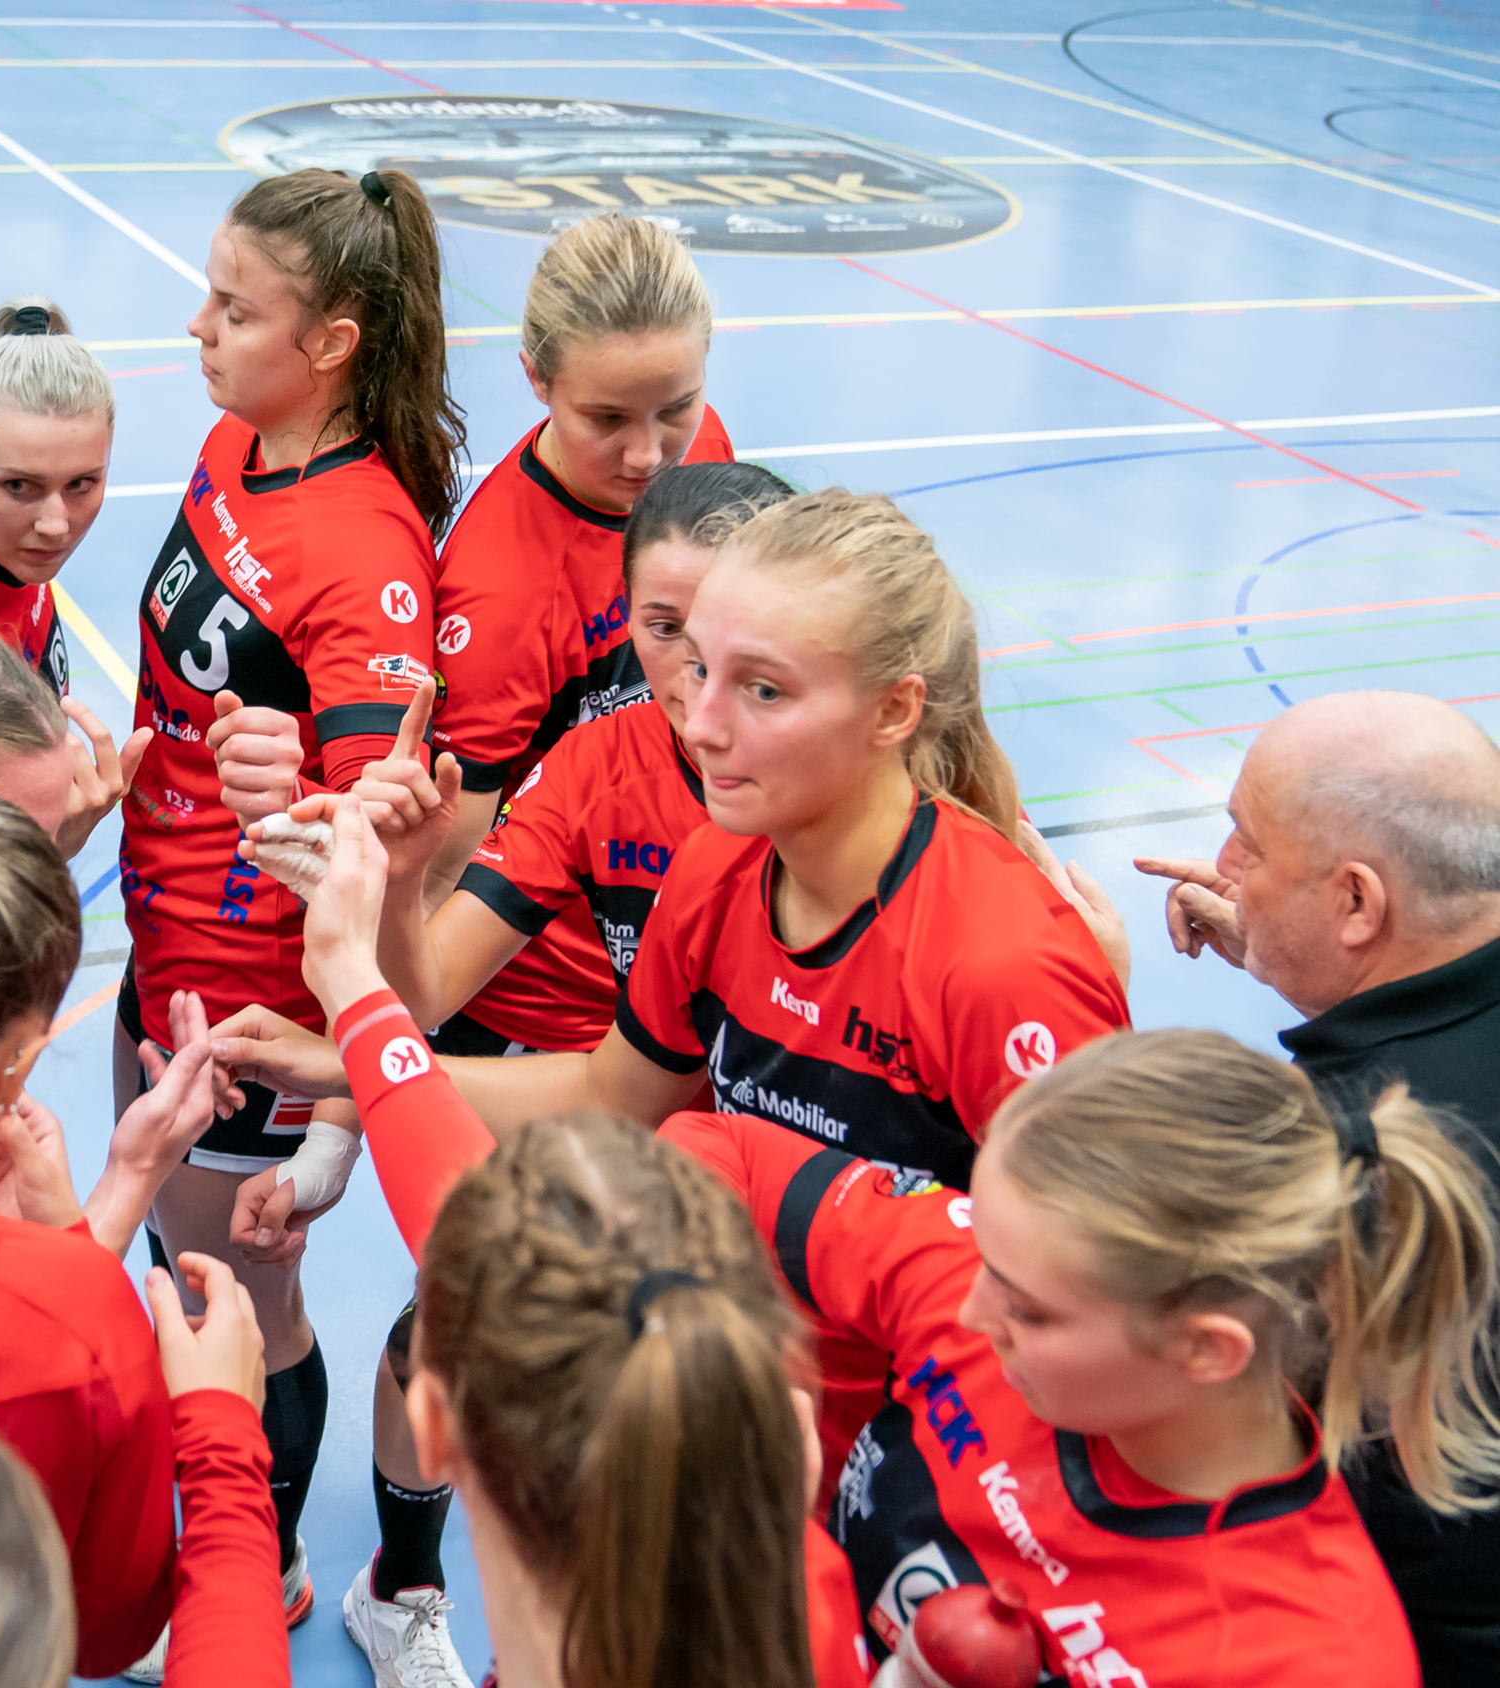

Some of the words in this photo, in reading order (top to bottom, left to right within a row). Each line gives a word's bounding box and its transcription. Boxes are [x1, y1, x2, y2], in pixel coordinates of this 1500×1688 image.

[436, 173, 934, 208] STARK
[211, 490, 238, 541] Kempa
[223, 536, 273, 595] hsc
[149, 594, 169, 627] SPAR
[180, 593, 250, 691] 5
[165, 789, 195, 813] 125
[219, 830, 262, 924] ASE
[731, 1076, 755, 1107] die
[757, 1086, 849, 1143] Mobiliar
[977, 1460, 1071, 1588] Kempa
